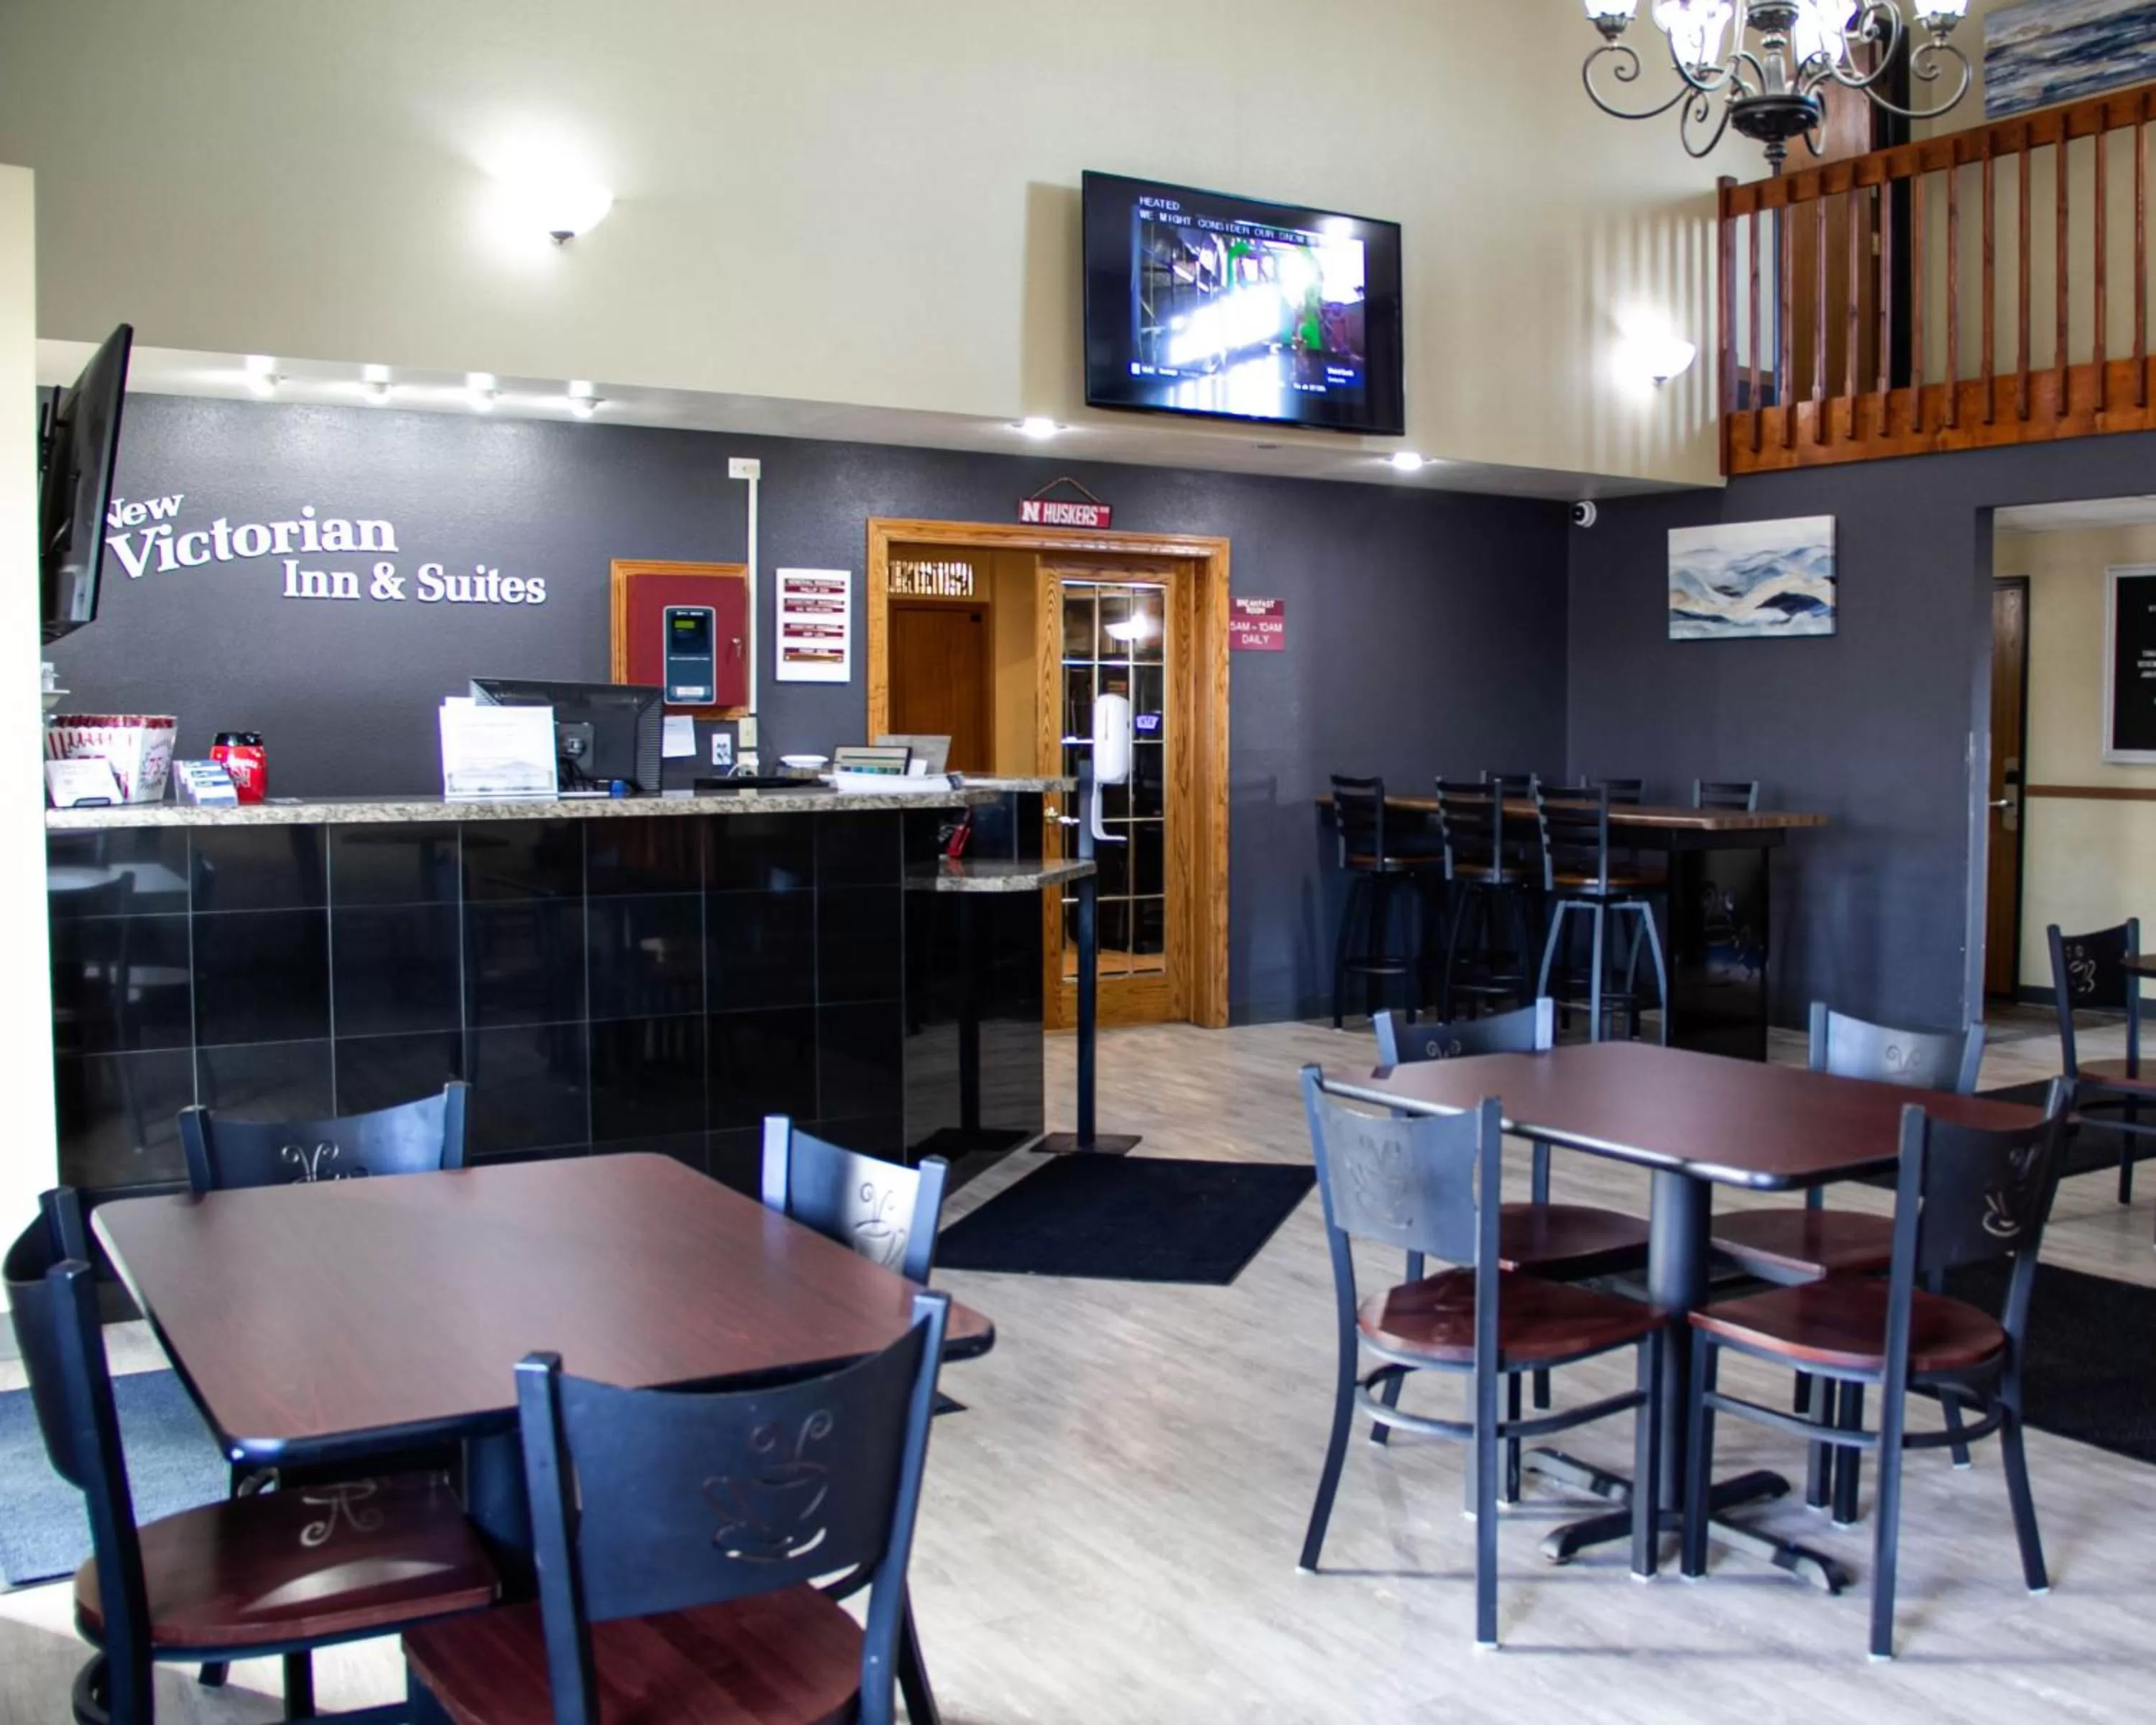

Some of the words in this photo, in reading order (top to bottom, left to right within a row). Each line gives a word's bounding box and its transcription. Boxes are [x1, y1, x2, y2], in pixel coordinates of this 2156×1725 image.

[1139, 210, 1154, 221] WE
[1159, 212, 1193, 226] MIGHT
[1043, 502, 1098, 526] HUSKERS
[106, 505, 399, 579] Victorian
[283, 559, 361, 599] Inn
[369, 561, 407, 600] &
[417, 564, 548, 604] Suites
[1241, 633, 1270, 645] DAILY
